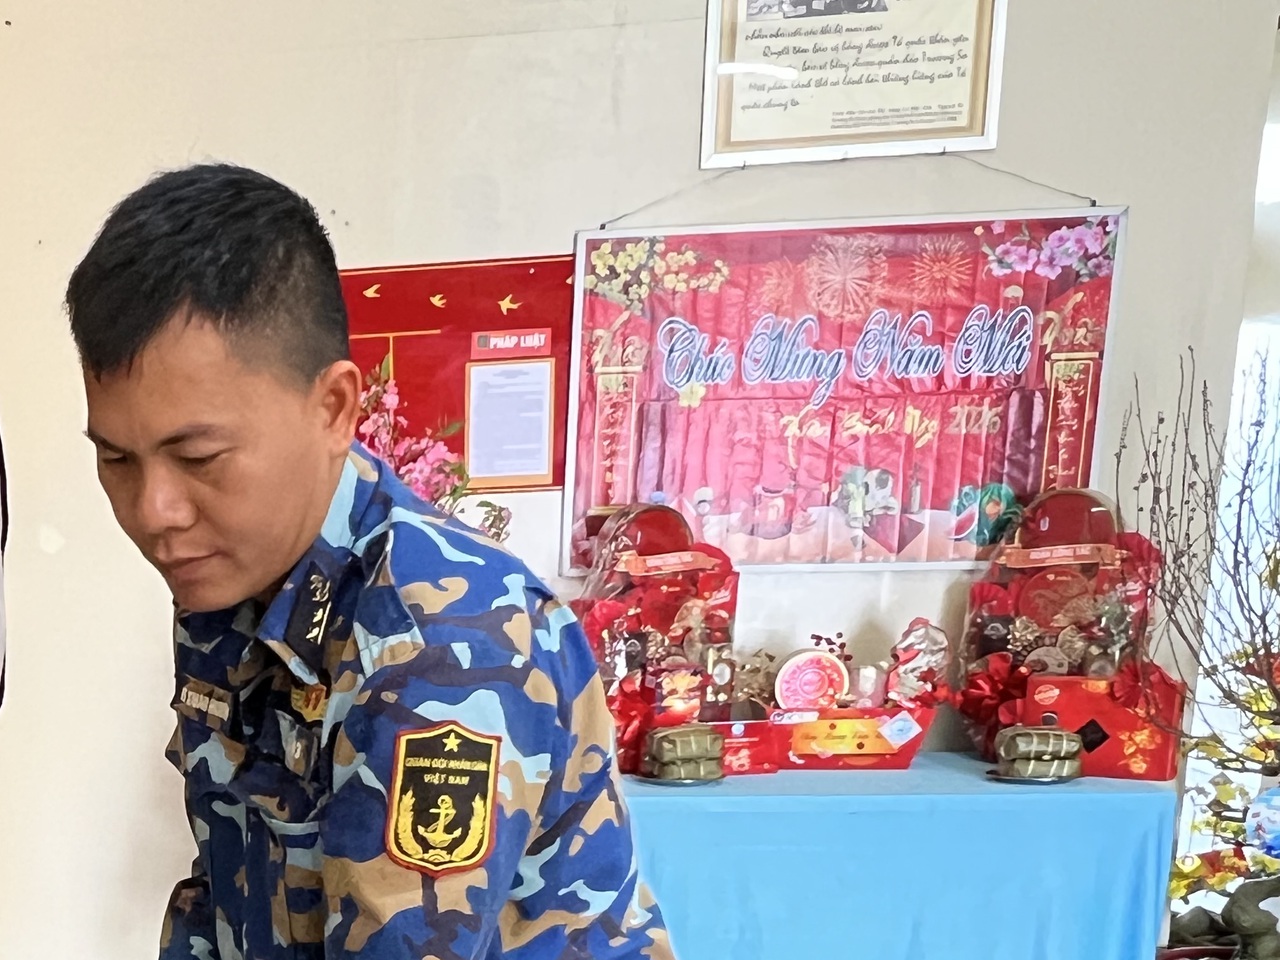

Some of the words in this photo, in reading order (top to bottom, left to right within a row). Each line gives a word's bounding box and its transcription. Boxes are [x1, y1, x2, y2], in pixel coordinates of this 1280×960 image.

[490, 334, 519, 350] PHÁP
[520, 332, 547, 350] LUẬT
[659, 318, 734, 390] Chúc
[853, 309, 944, 379] Năm
[423, 772, 447, 786] VIỆT
[448, 775, 470, 786] NAM
